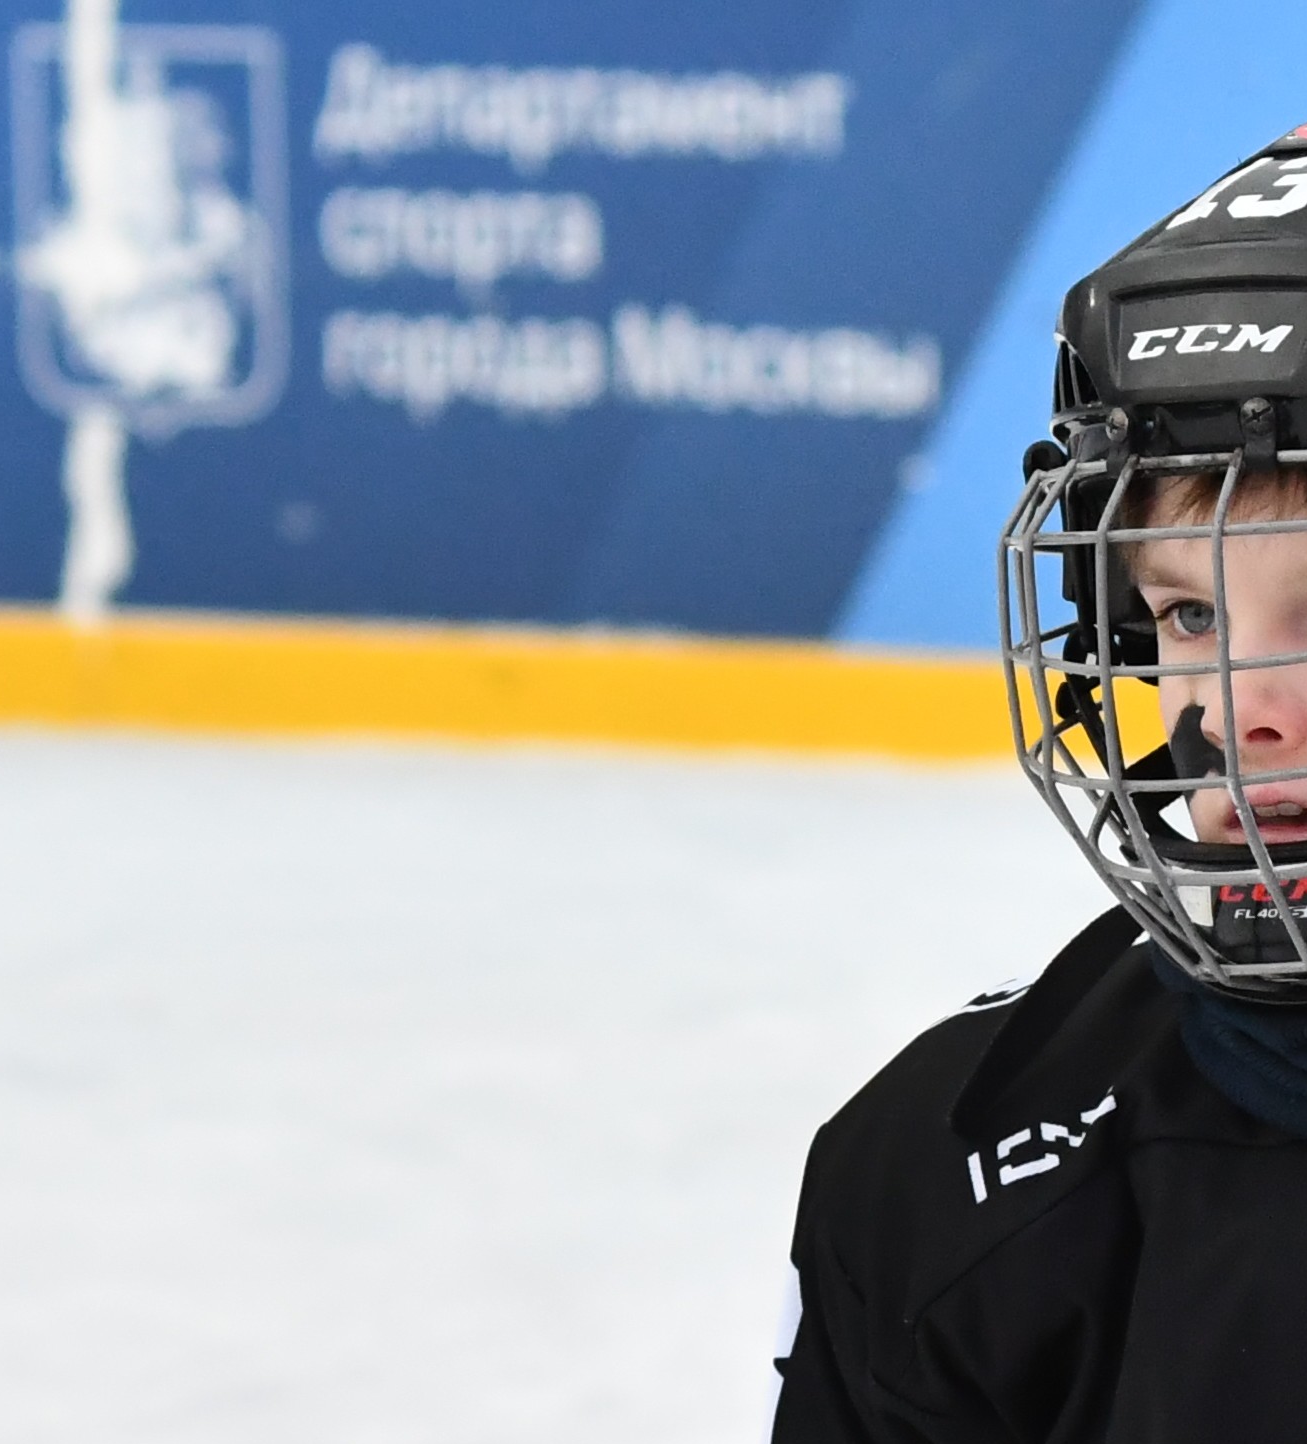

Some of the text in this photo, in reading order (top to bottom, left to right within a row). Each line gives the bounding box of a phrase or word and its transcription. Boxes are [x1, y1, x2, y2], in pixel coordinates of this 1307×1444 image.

[313, 42, 847, 176] Департамент
[318, 187, 604, 305] спорта
[321, 302, 941, 428] города Москвы
[1127, 323, 1294, 363] CCM
